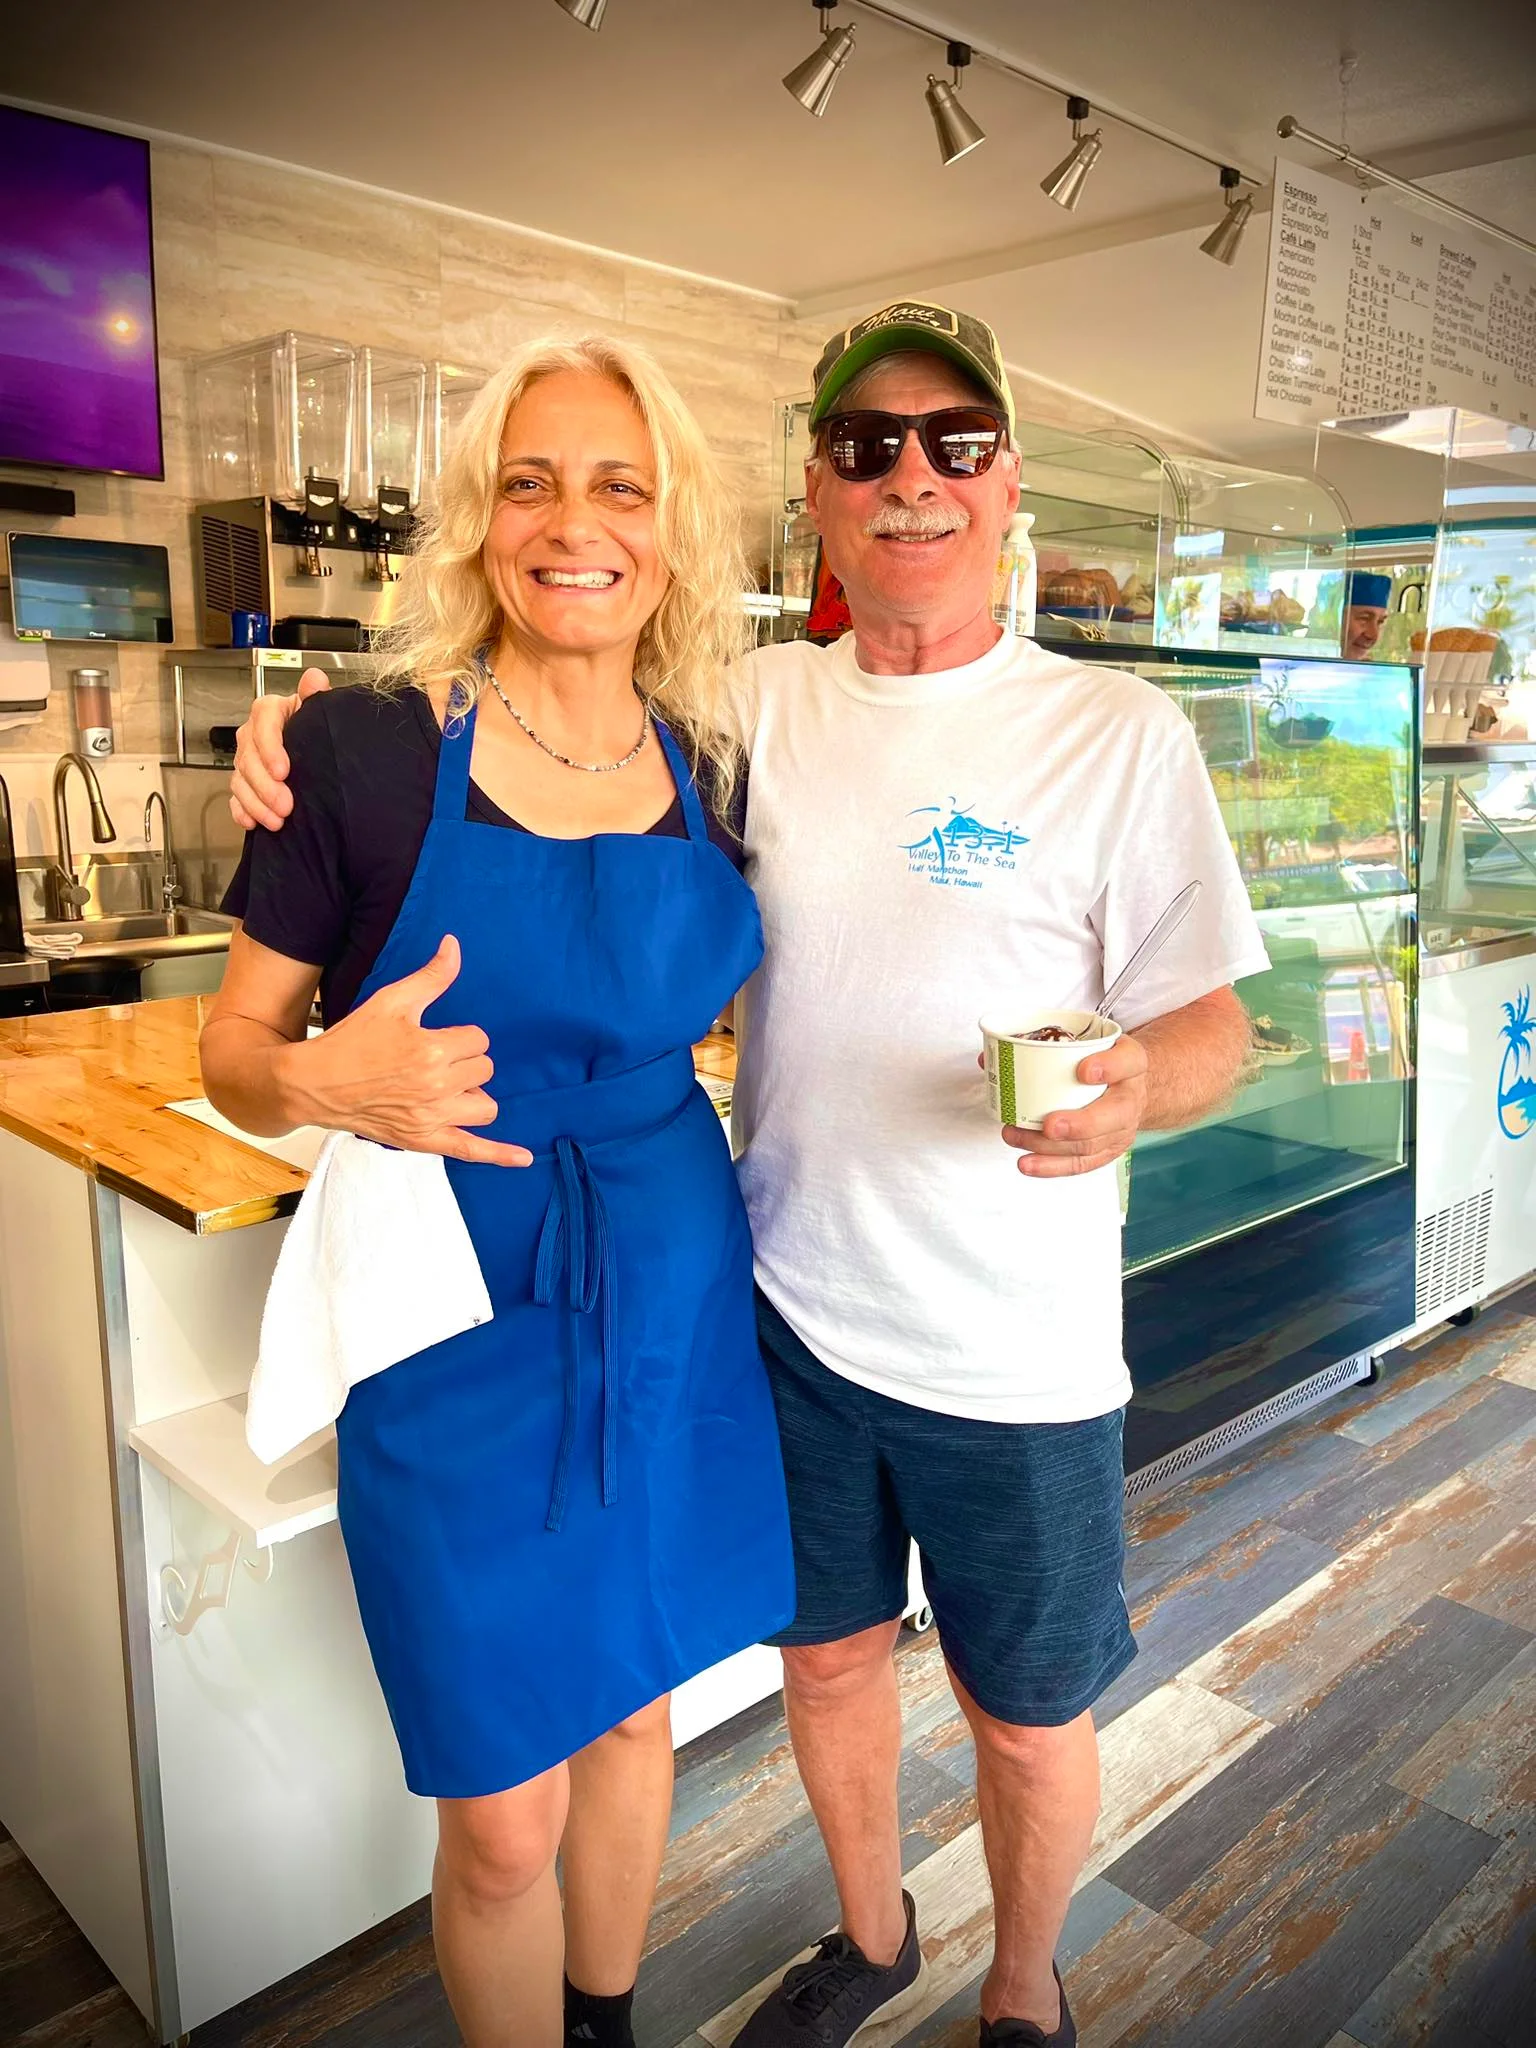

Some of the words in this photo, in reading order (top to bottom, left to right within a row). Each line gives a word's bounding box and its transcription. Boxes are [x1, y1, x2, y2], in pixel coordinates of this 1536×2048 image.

[1283, 182, 1318, 204] Espresso
[1281, 213, 1313, 235] Espresso
[1299, 236, 1317, 251] Latte
[908, 847, 940, 862] Valley
[947, 849, 961, 863] To
[966, 851, 990, 866] The
[994, 856, 1016, 869] Sea
[908, 863, 924, 874] Half
[927, 864, 969, 876] Marathon
[953, 878, 984, 890] Hawaii
